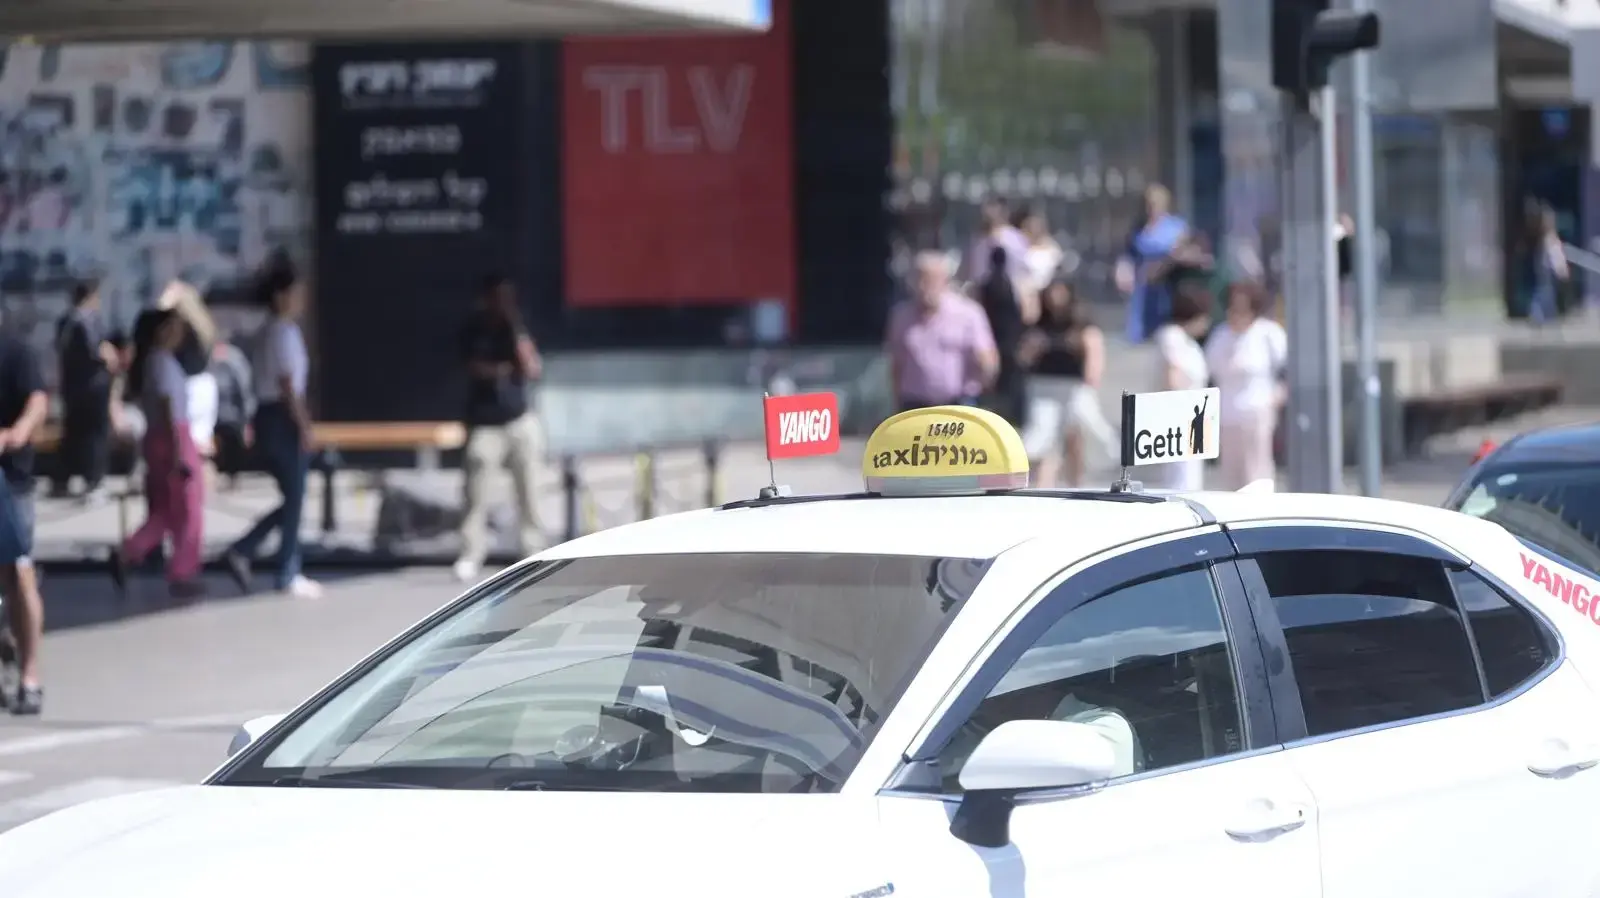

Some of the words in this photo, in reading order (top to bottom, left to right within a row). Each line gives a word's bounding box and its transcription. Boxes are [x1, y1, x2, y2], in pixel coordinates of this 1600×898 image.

[583, 63, 756, 153] TLV
[779, 408, 831, 445] YANGO
[927, 422, 965, 437] 15498
[1135, 426, 1183, 459] Gett
[873, 435, 920, 468] taxi
[920, 443, 988, 466] מונית
